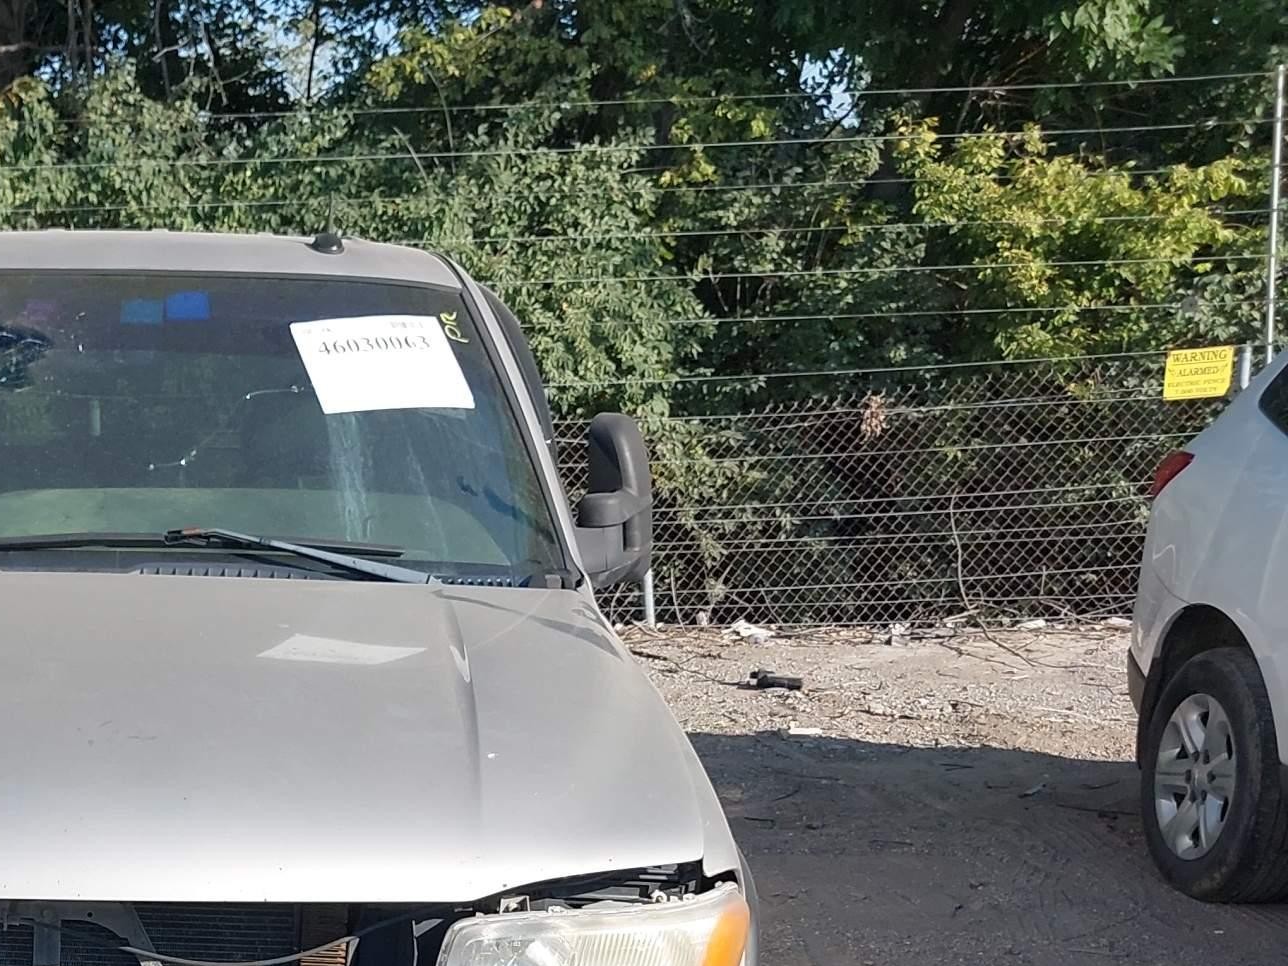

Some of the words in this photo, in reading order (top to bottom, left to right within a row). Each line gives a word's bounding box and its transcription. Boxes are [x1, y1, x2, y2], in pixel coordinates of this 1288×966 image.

[318, 335, 433, 355] 46030063
[1172, 350, 1227, 362] WARNING
[1177, 366, 1220, 377] ALARMED
